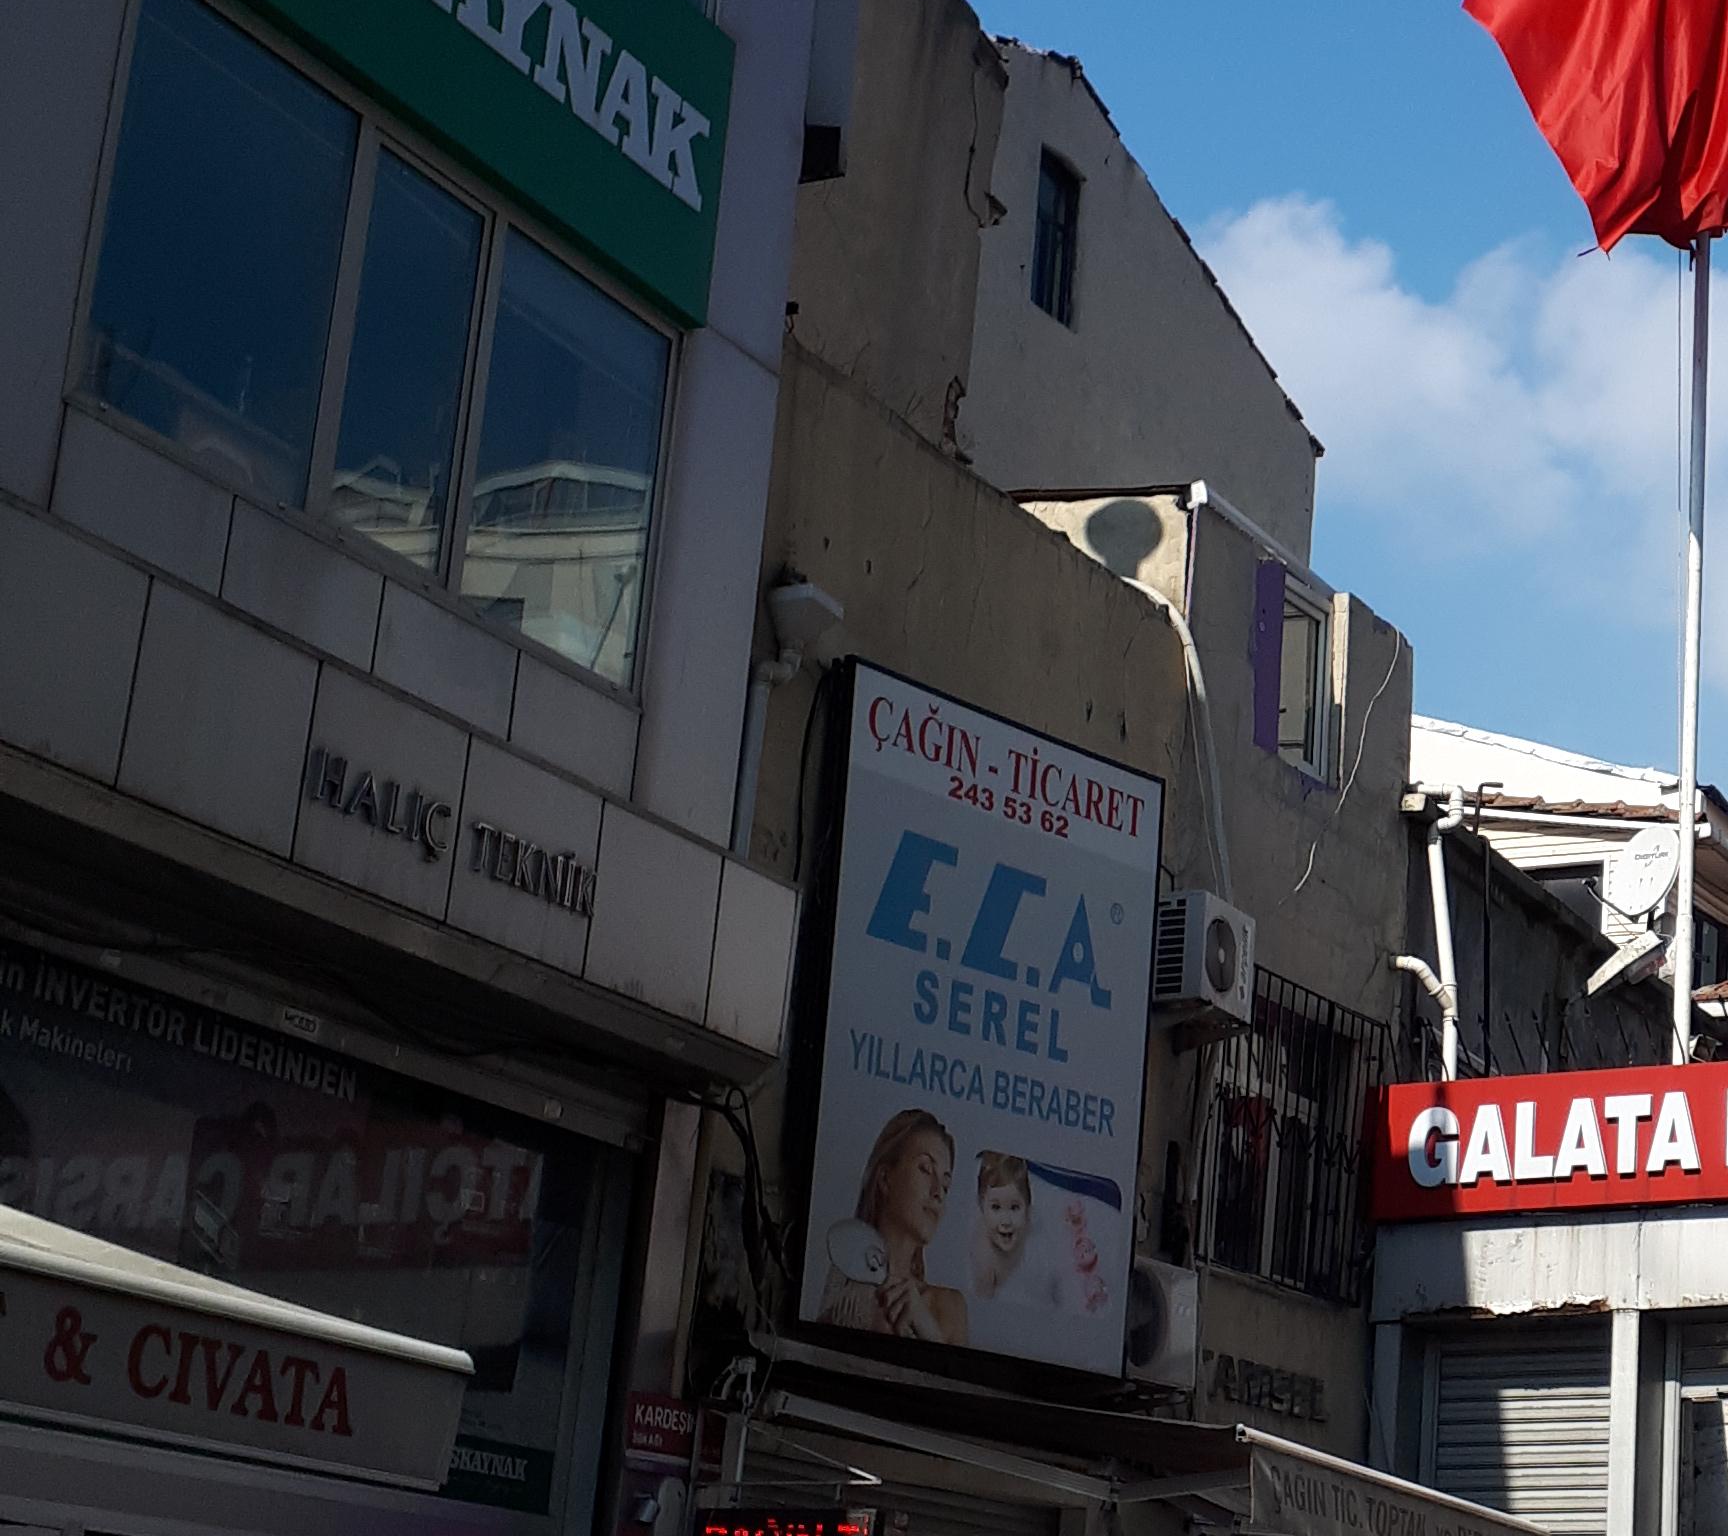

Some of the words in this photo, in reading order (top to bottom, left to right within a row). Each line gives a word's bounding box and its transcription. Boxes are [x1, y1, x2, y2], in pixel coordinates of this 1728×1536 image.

[868, 696, 980, 777] ÇAĞIN
[1007, 747, 1145, 838] TİCARET
[948, 775, 994, 811] 243
[1002, 795, 1032, 825] 53
[1040, 809, 1069, 838] 62
[473, 820, 598, 916] TEKNİK
[192, 1013, 357, 1104] LİDERİNDEN
[913, 969, 1069, 1063] SEREL
[850, 1027, 986, 1105] YILLARCA
[992, 1070, 1116, 1137] BERABER
[1407, 1090, 1702, 1190] GALATA
[43, 1305, 97, 1385] &
[127, 1323, 352, 1437] CIVATA
[1202, 1349, 1327, 1423] AMSEL
[449, 1446, 529, 1482] SKAYNAK
